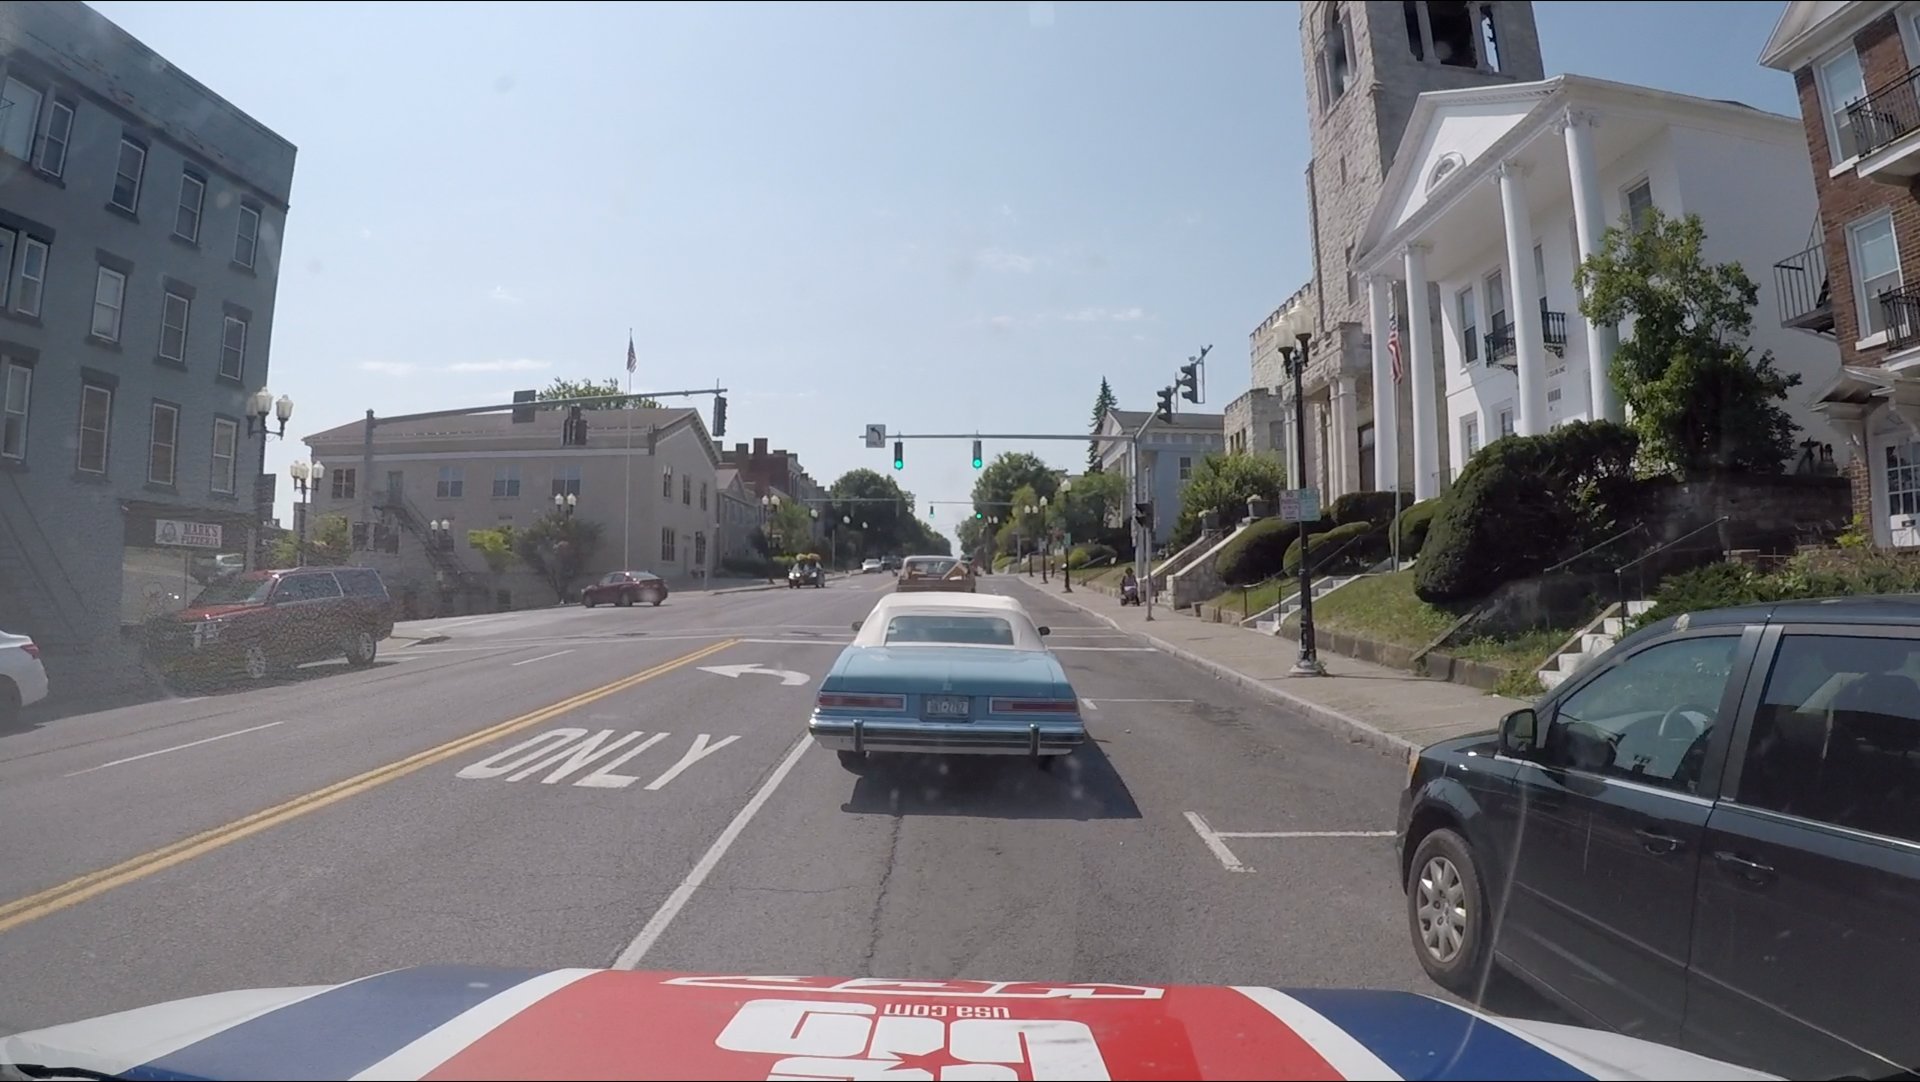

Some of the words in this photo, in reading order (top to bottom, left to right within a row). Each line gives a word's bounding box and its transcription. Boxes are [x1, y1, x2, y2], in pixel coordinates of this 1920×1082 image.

[183, 523, 218, 537] MARK'S
[455, 727, 743, 791] ONLY
[883, 1003, 1010, 1019] usa.com
